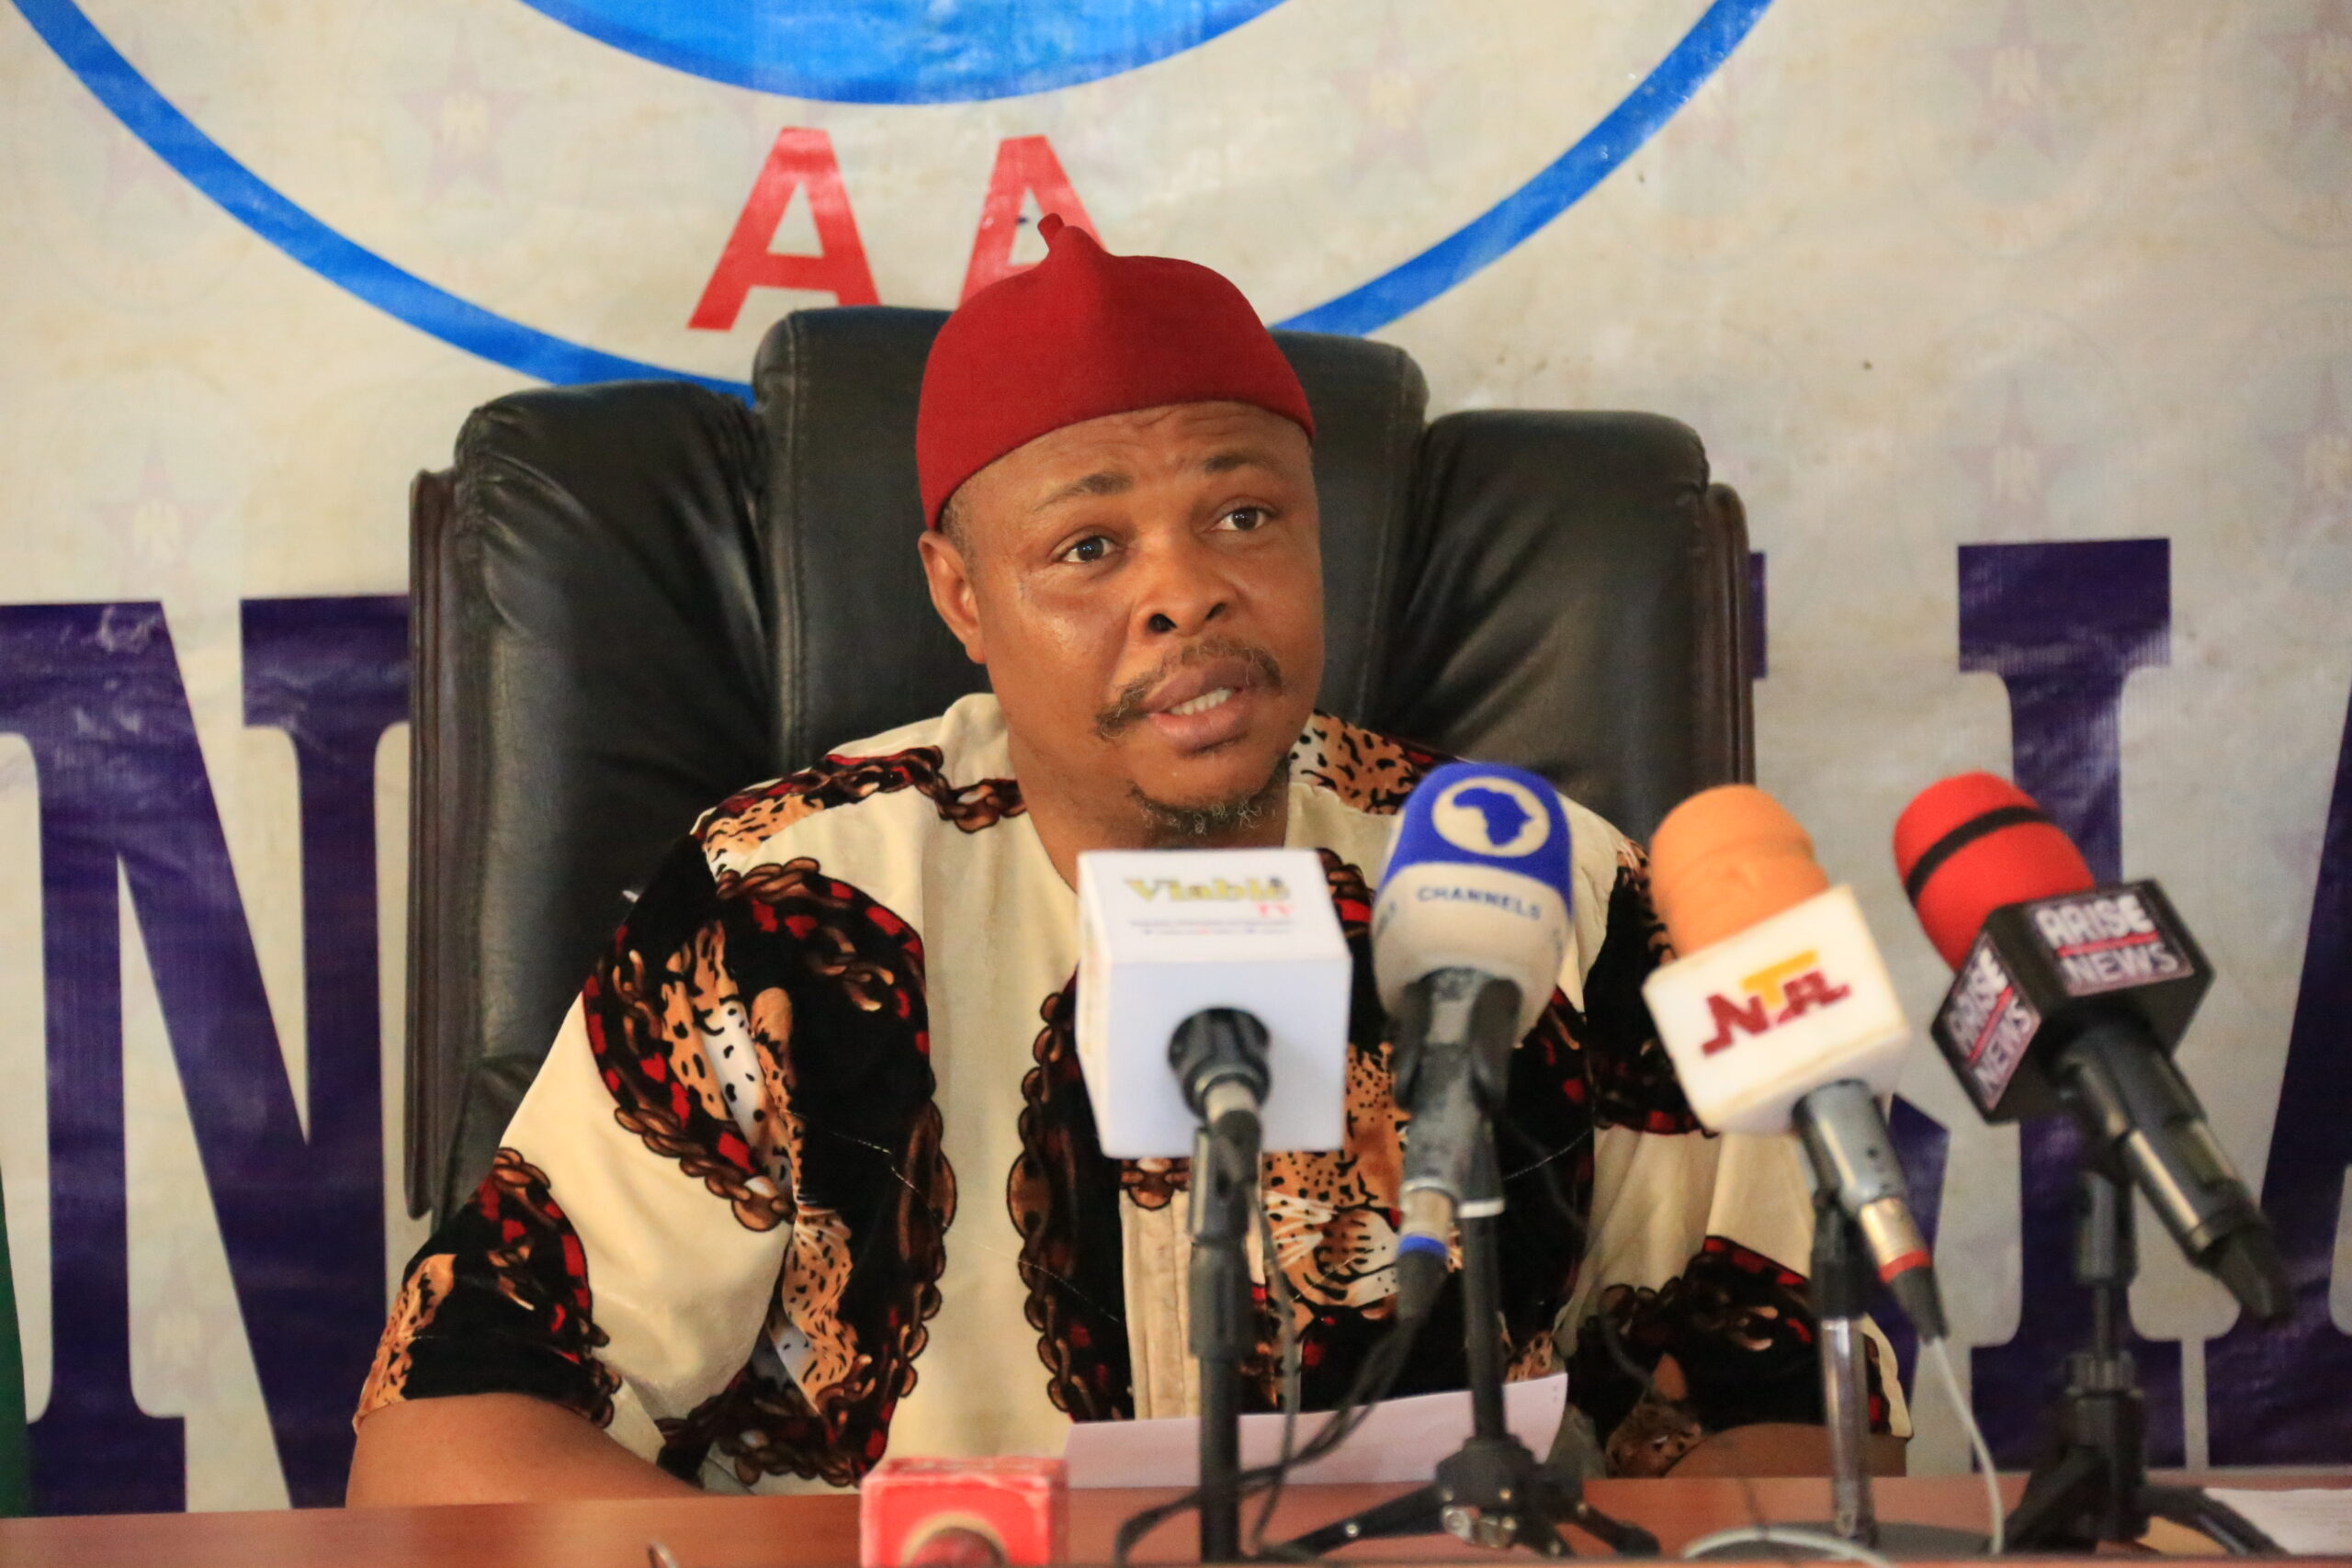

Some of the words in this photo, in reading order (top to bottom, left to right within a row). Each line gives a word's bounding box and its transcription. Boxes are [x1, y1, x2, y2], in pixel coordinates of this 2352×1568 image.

[1417, 886, 1541, 919] CHANNELS
[2034, 894, 2156, 949] ARISE
[2060, 942, 2179, 988] NEWS
[1701, 949, 1852, 1057] NTA
[1973, 997, 2034, 1093] NEWS
